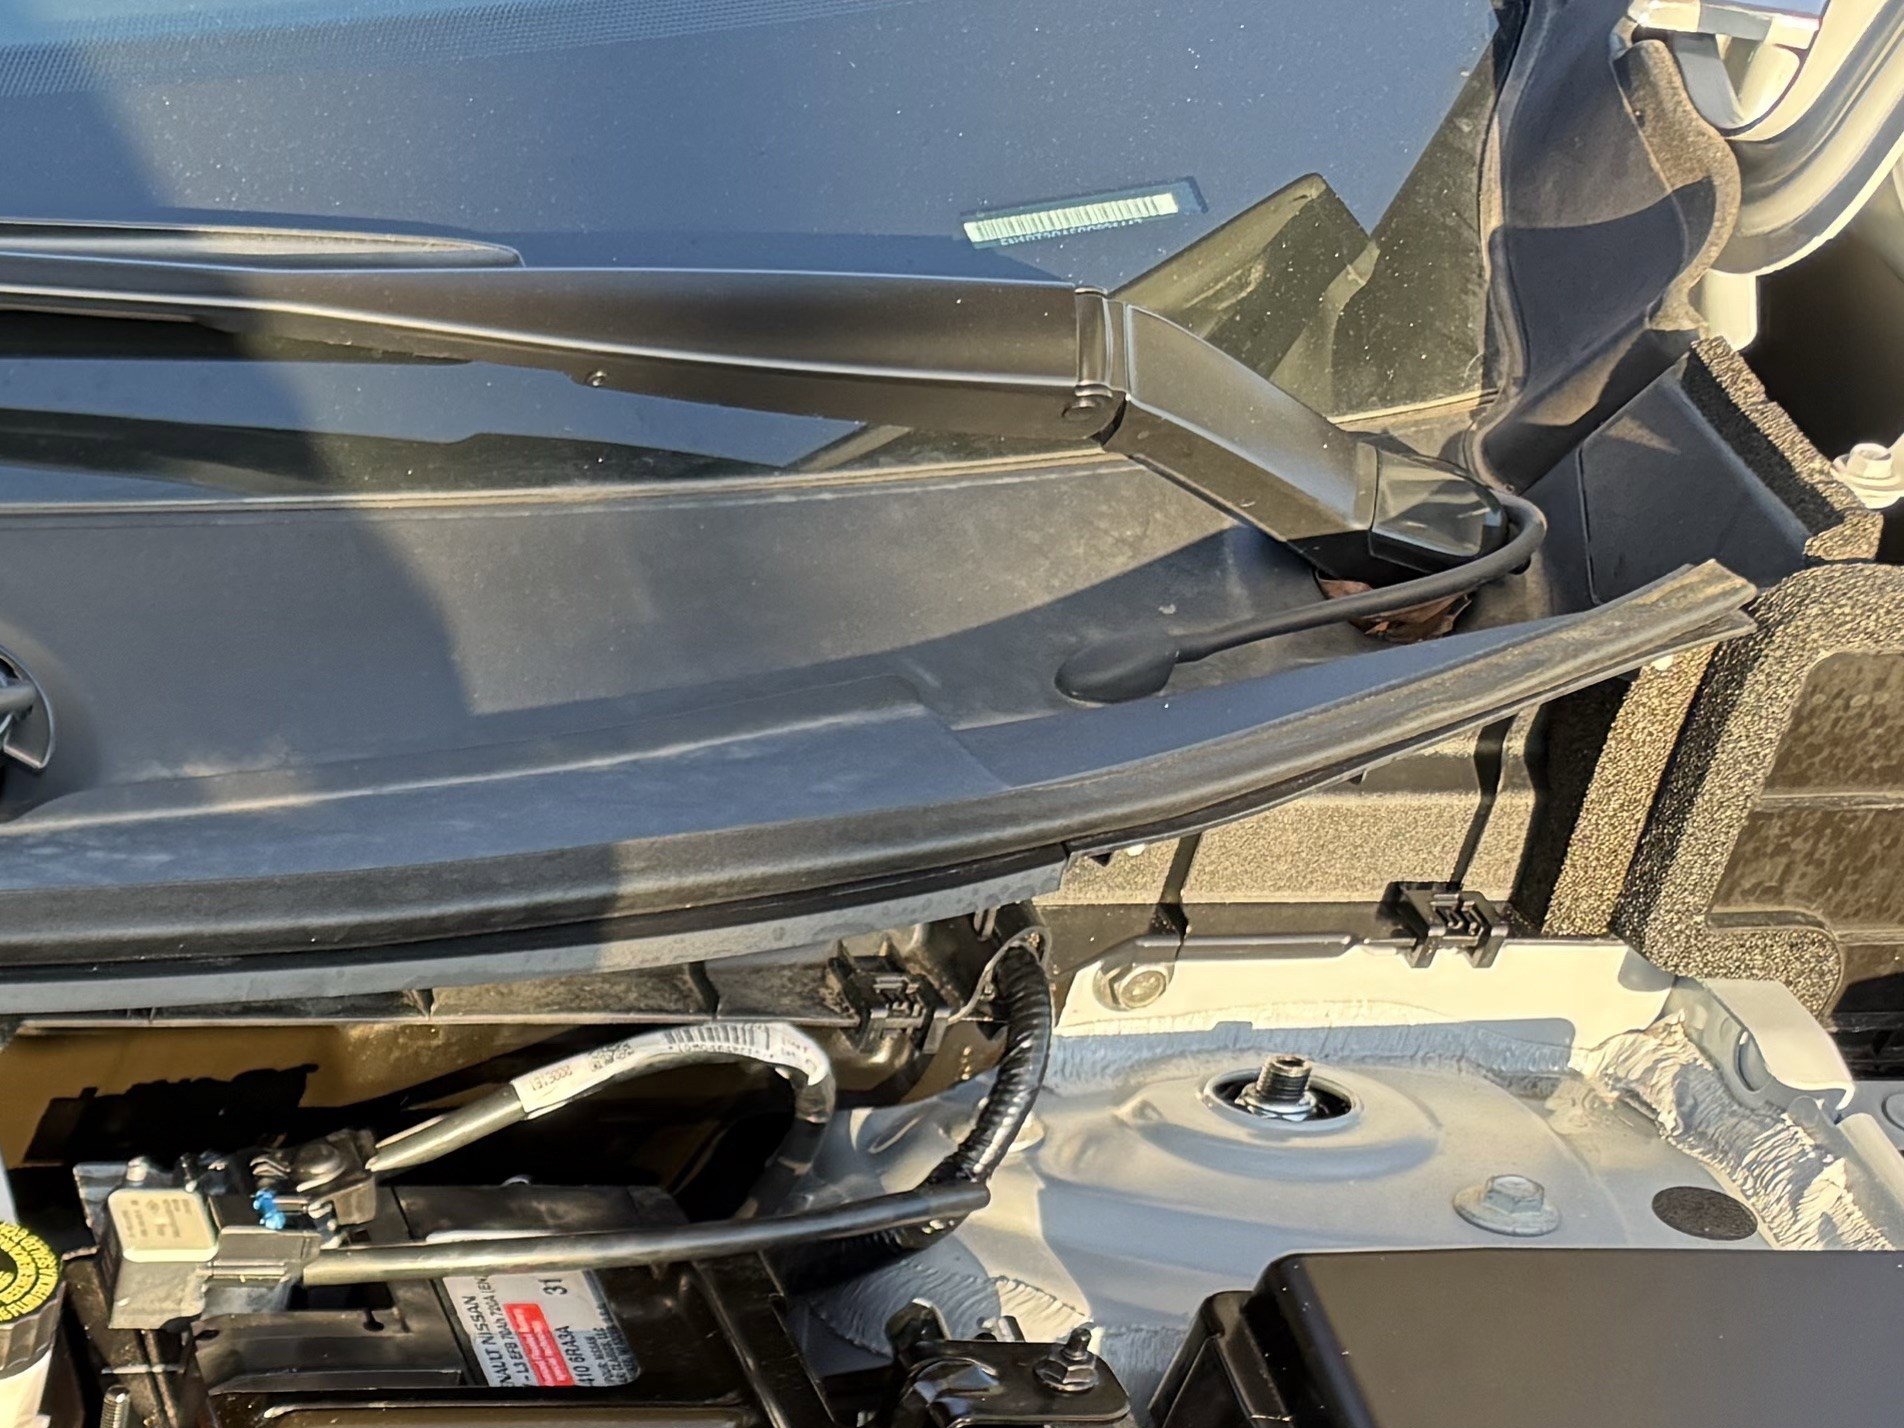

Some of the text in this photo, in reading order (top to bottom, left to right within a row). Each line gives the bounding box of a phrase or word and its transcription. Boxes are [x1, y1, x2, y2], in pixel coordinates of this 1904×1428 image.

[538, 1278, 568, 1295] 31
[462, 1295, 496, 1345] NISSAN
[554, 1325, 585, 1363] 6RA3A
